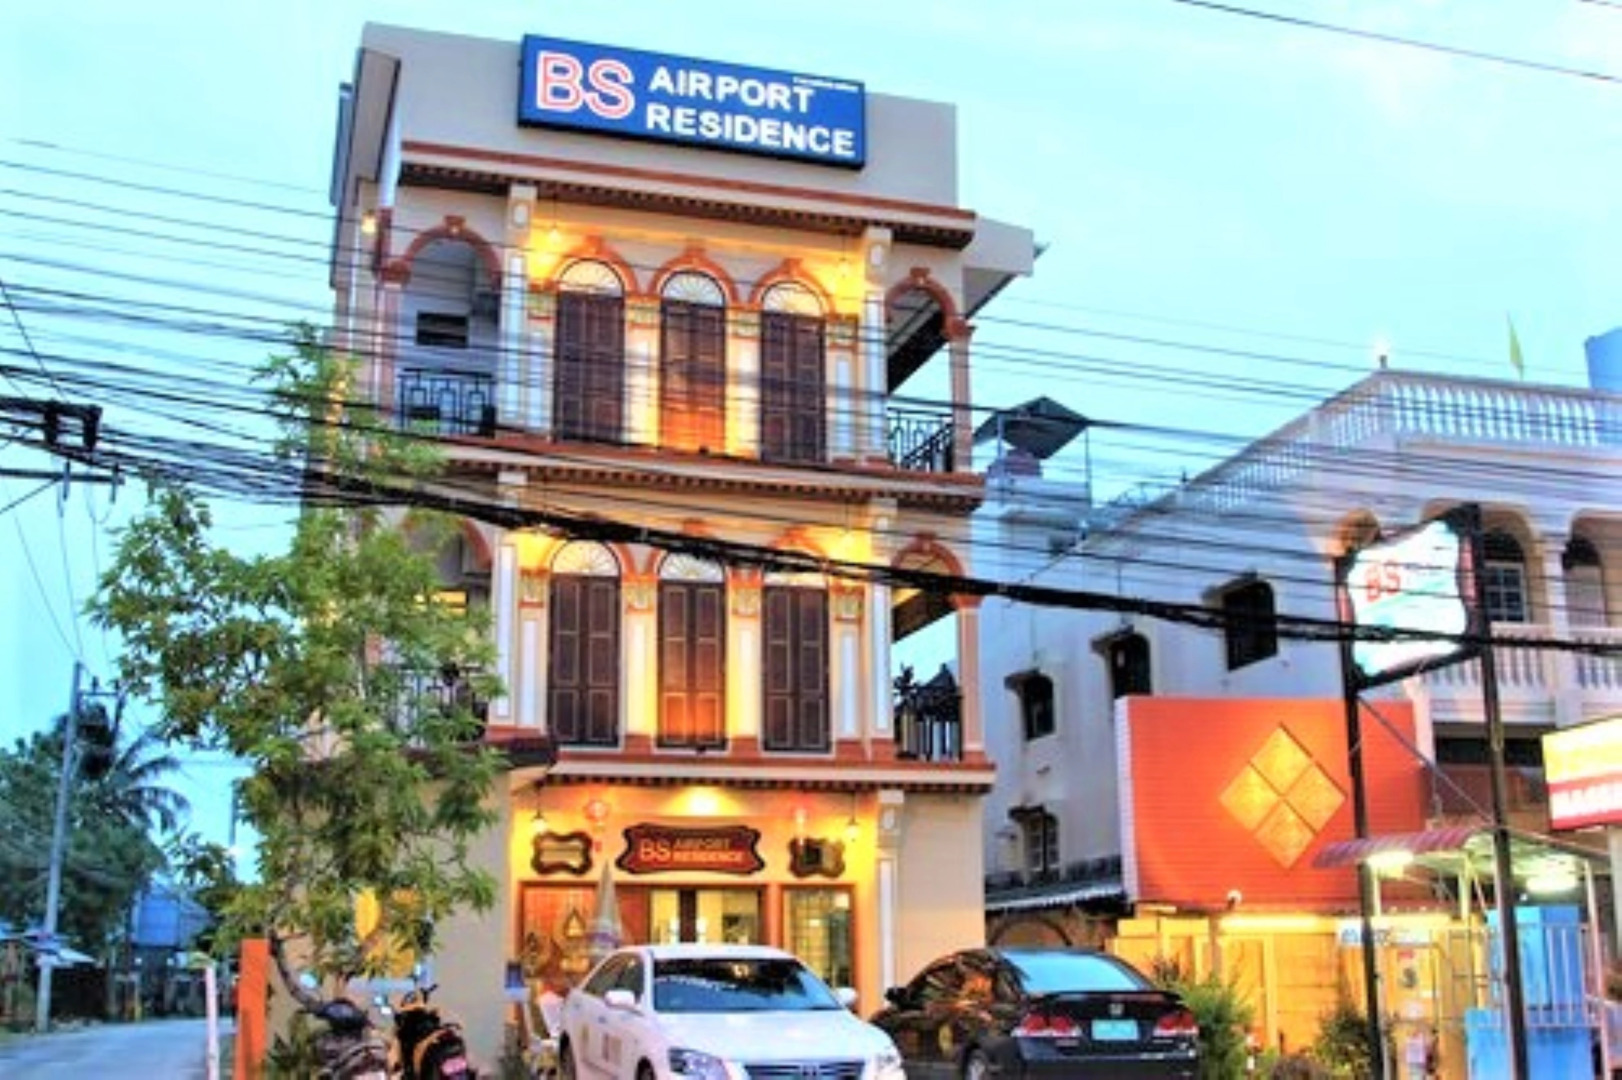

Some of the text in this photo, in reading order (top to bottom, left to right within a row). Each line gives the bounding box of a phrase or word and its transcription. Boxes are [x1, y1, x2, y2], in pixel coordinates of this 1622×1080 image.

[536, 50, 635, 119] BS
[649, 66, 814, 113] AIRPORT
[646, 103, 855, 156] RESIDENCE
[640, 839, 672, 862] BS
